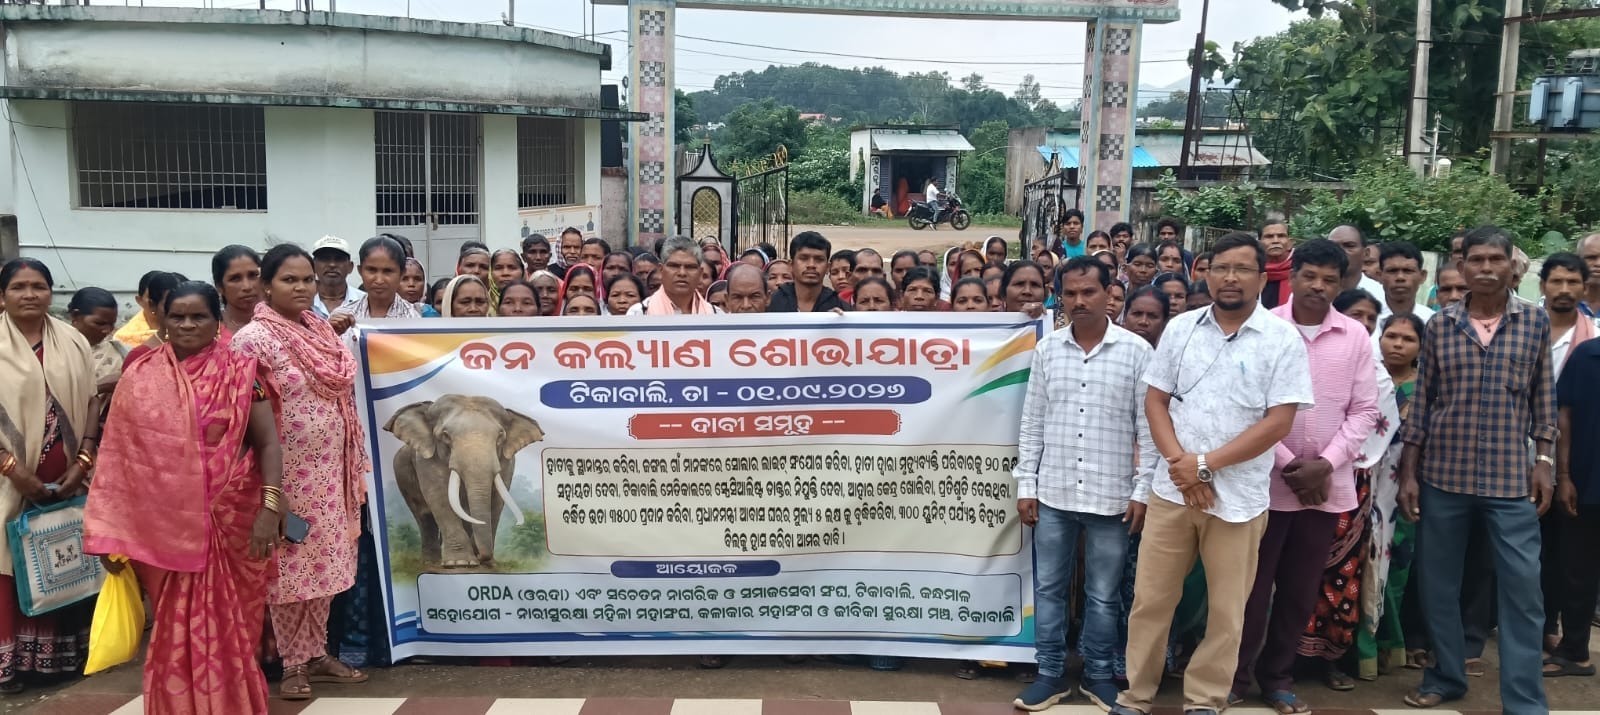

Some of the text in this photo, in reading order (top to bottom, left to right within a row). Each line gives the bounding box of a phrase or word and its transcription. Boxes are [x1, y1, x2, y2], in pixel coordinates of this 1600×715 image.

[459, 337, 970, 371] ଜନ କଲ୍ୟାଣ ଶୋଭାଯାତ୍ରା
[569, 381, 673, 405] ଟିକାବାଲି,
[682, 385, 708, 402] ତା
[737, 383, 906, 402] ୦୧.୦୯.୨୦୨୬
[691, 417, 745, 433] ଦାବୀ
[754, 414, 814, 435] ସମୂହ
[855, 455, 874, 475] ହାତୀ
[985, 457, 999, 471] ୨୦
[609, 508, 637, 523] ୩୫୦୦
[898, 505, 919, 520] ୩୦୦
[769, 528, 794, 549] କରିବା
[796, 532, 821, 548] ଆମର
[467, 585, 513, 602] ORDA
[575, 588, 602, 601] ଏବଂ
[606, 588, 661, 601] ସଚେତନ
[666, 585, 719, 602] ନାଗରିକ
[723, 588, 736, 600] ଓ
[740, 585, 816, 599] ସମାଜସେବୀ
[592, 603, 632, 622] ମହିଳା
[697, 605, 754, 619] କଳାକାର
[817, 605, 829, 617] ଓ
[958, 605, 1015, 623] ଟିକାବାଲି
